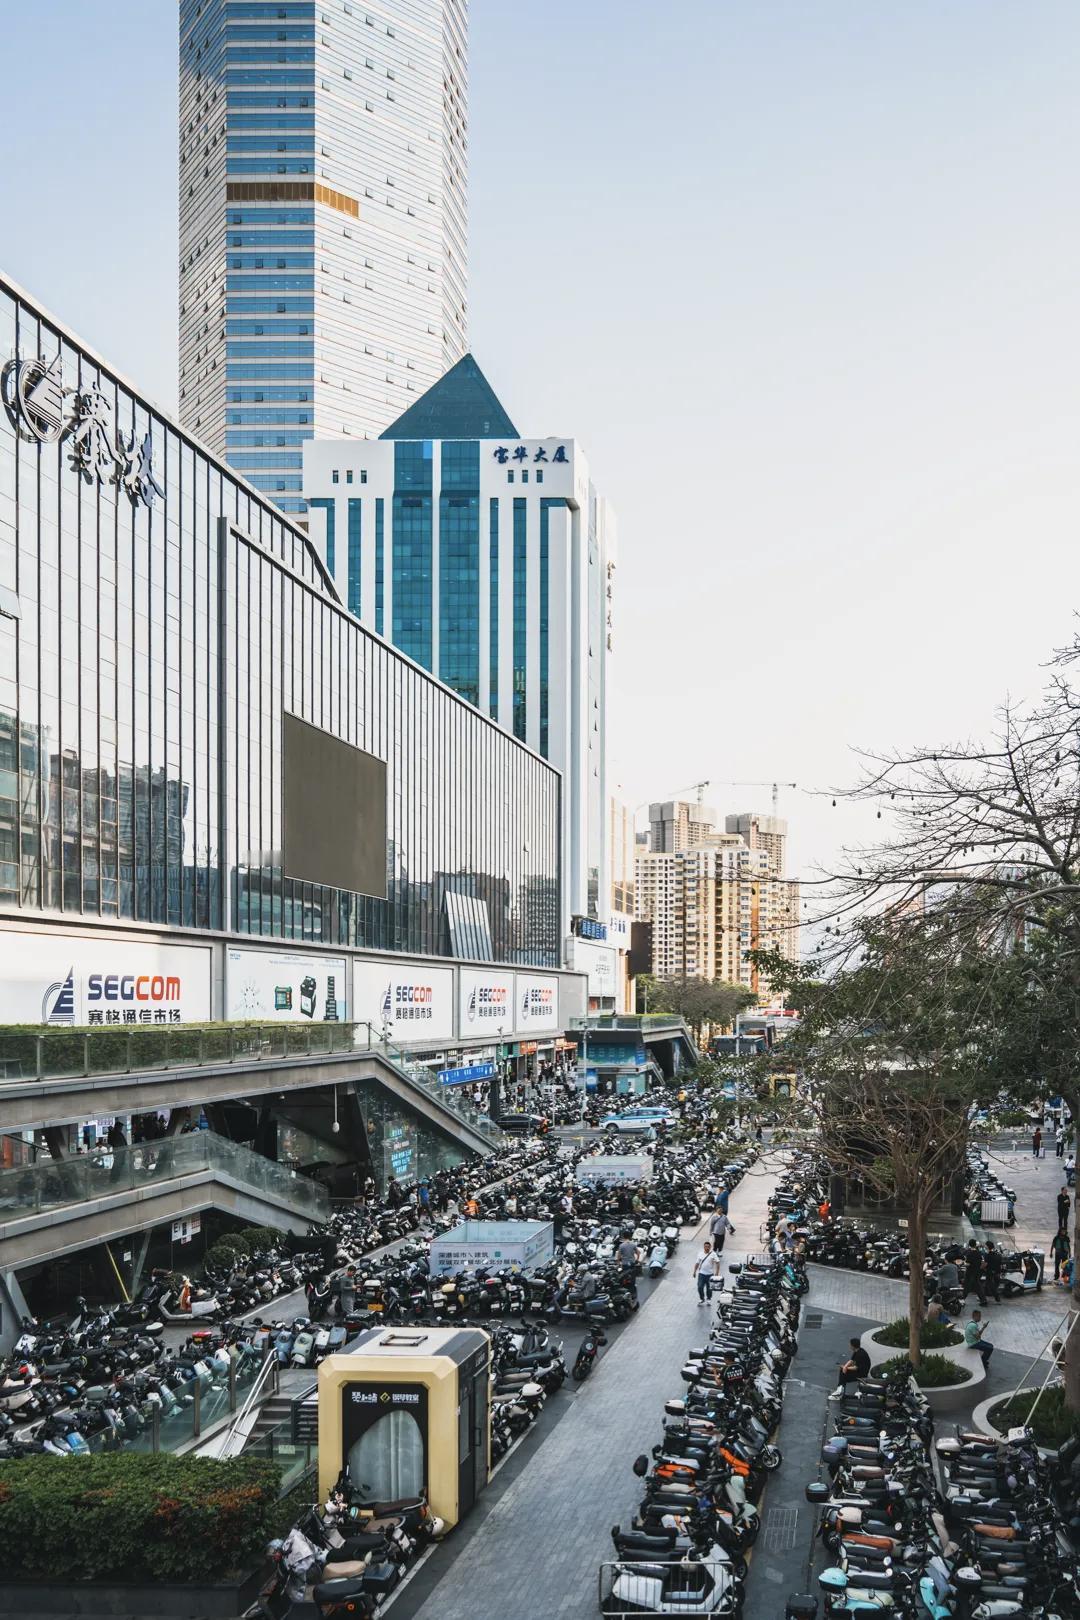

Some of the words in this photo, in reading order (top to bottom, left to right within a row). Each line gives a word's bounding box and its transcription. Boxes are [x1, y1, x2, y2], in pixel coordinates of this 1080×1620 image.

[493, 446, 570, 465] 宝华大厦
[88, 974, 181, 1000] SEGCOM
[396, 985, 432, 1003] SEGCOM
[479, 988, 506, 1003] SEGCOM
[531, 988, 552, 1002] SEGCOM
[88, 1008, 181, 1025] 赛格通信市场
[396, 1007, 432, 1021] 赛格通信市场
